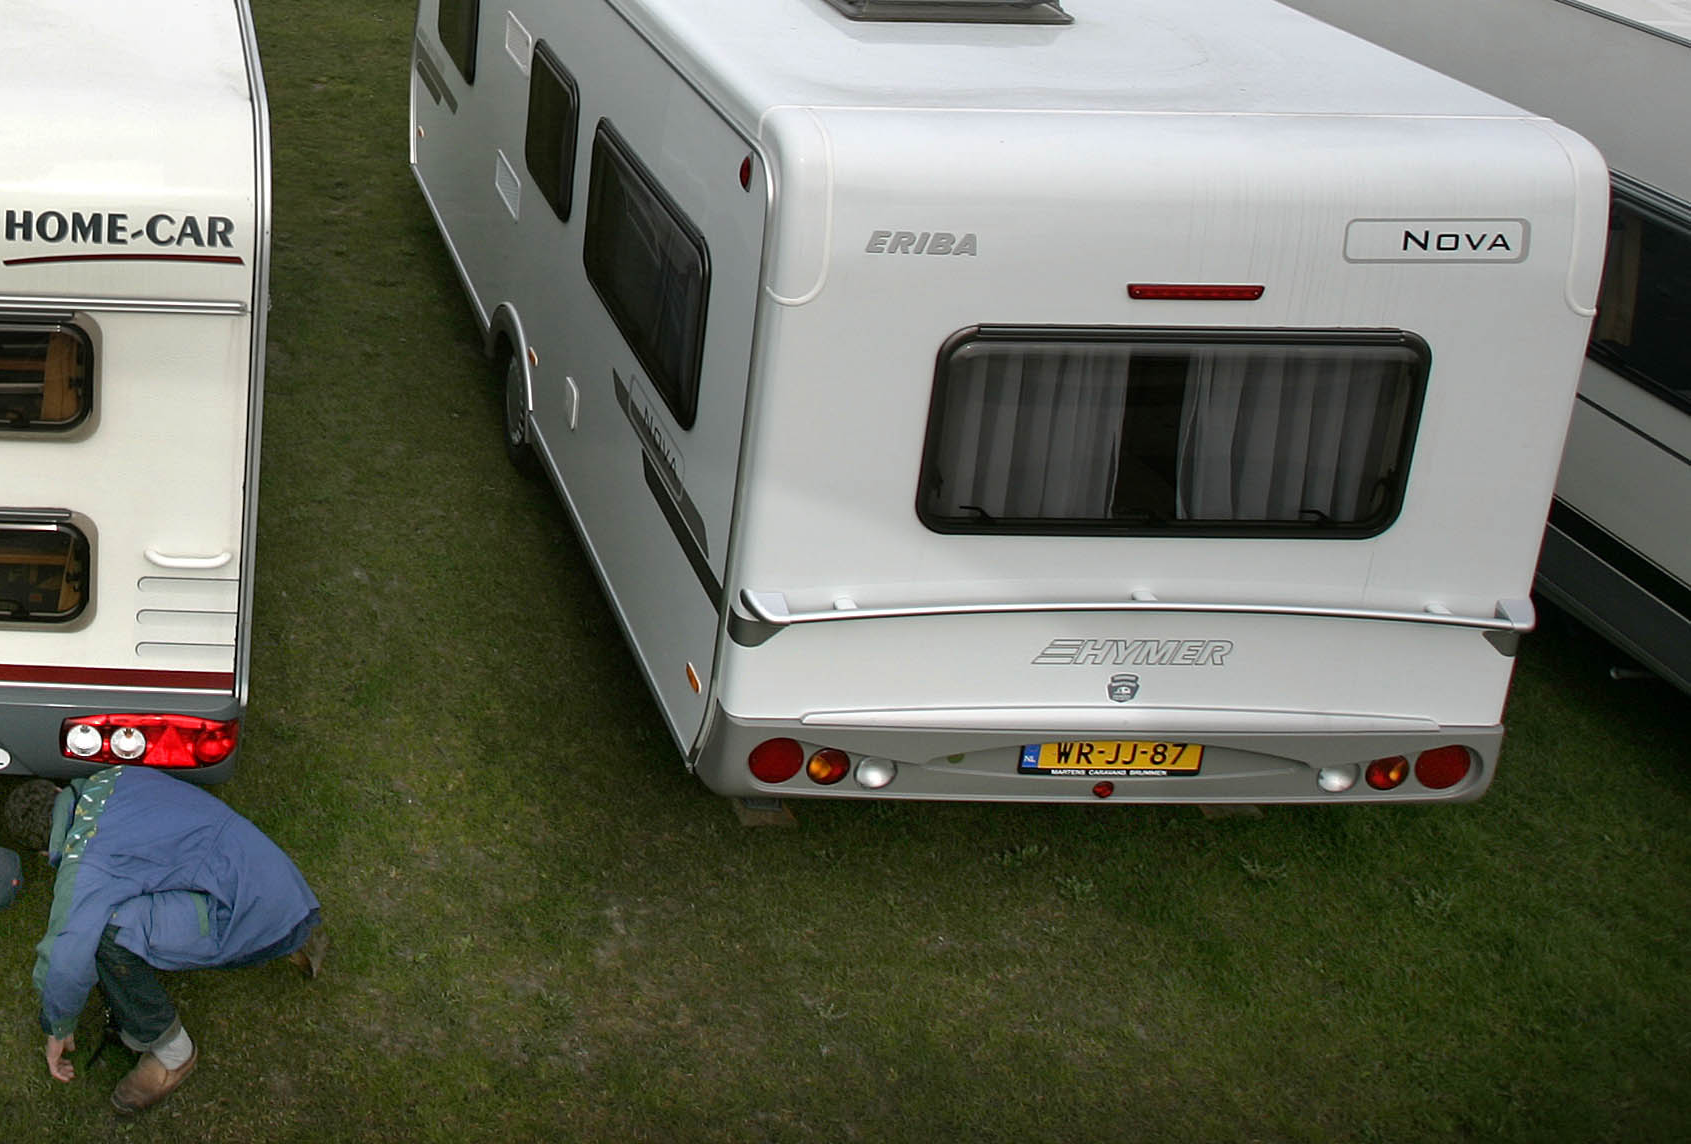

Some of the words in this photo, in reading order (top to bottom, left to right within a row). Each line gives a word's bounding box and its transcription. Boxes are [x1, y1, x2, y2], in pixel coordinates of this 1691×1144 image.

[5, 209, 236, 249] HOME-CAR
[865, 230, 978, 257] ERIBA
[1070, 639, 1234, 666] HYMER
[1055, 742, 1189, 765] WR-JJ-87
